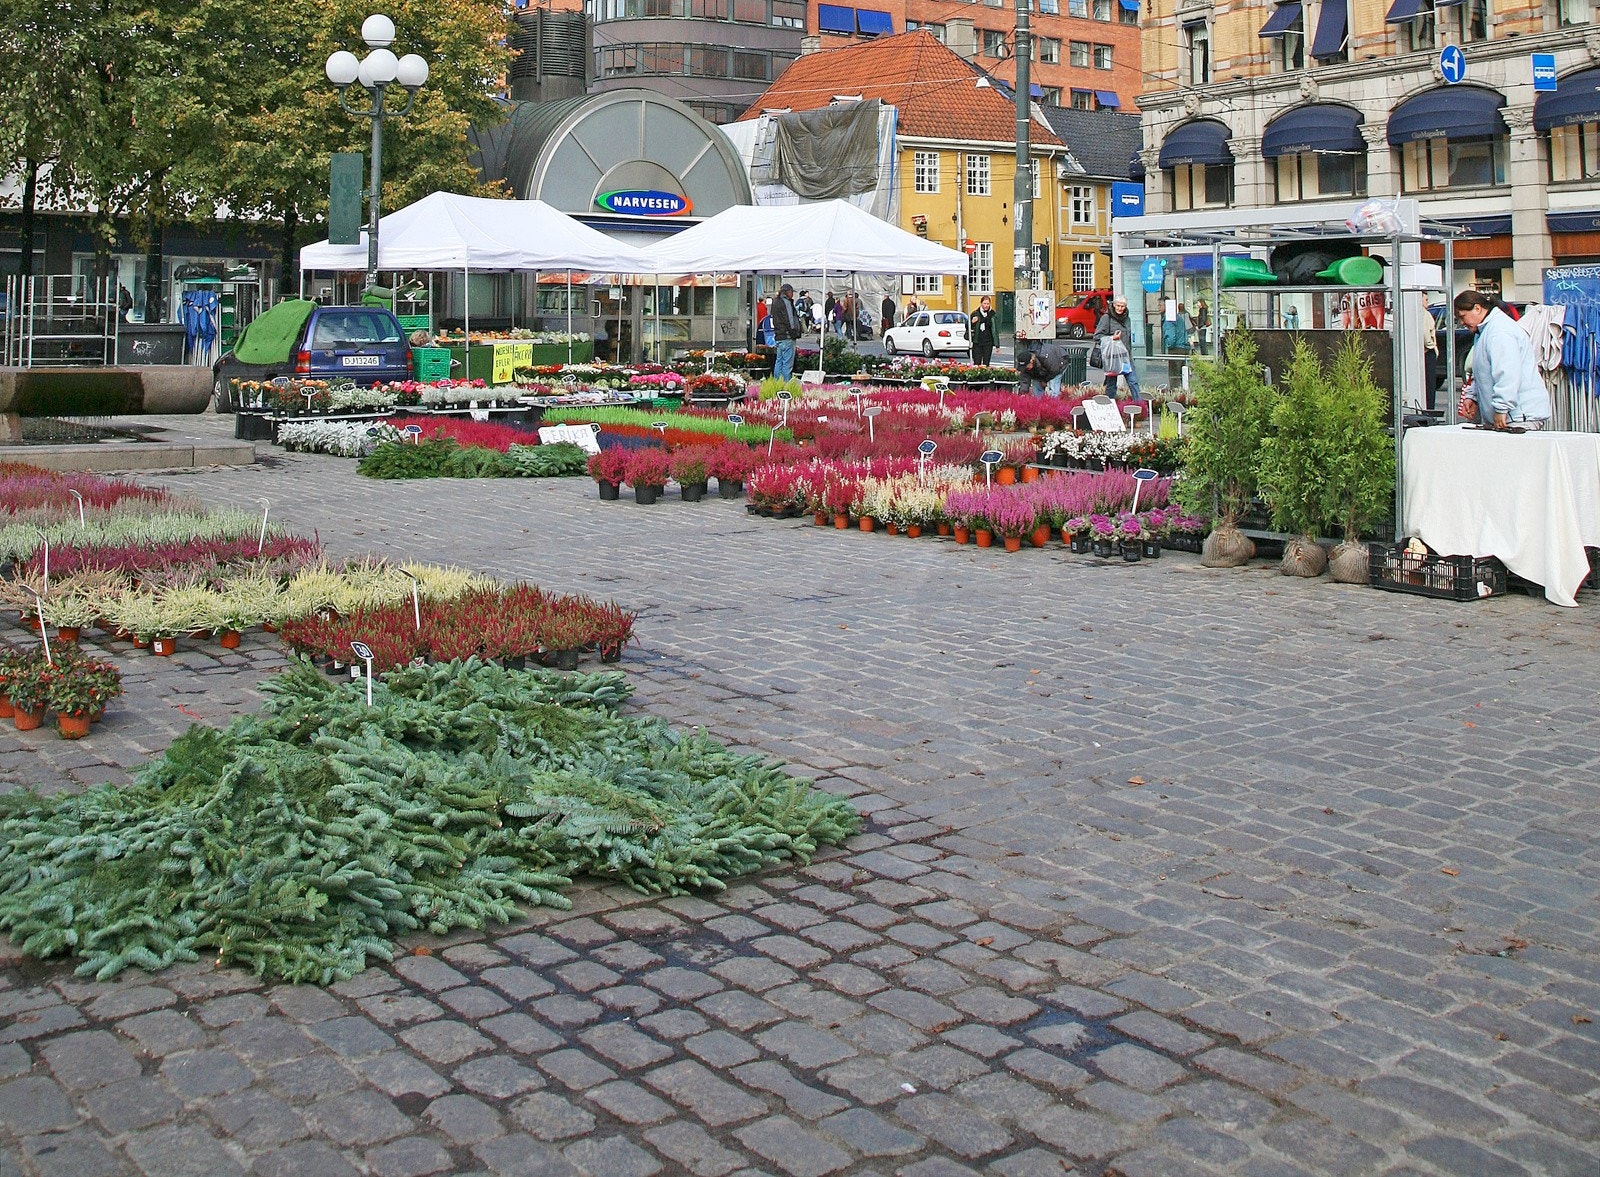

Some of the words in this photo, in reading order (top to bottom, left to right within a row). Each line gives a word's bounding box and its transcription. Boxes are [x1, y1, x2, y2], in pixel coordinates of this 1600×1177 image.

[613, 196, 679, 210] NARVESEN
[1147, 263, 1156, 280] 5
[1359, 293, 1379, 308] GRIS
[551, 428, 589, 441] ERIKA
